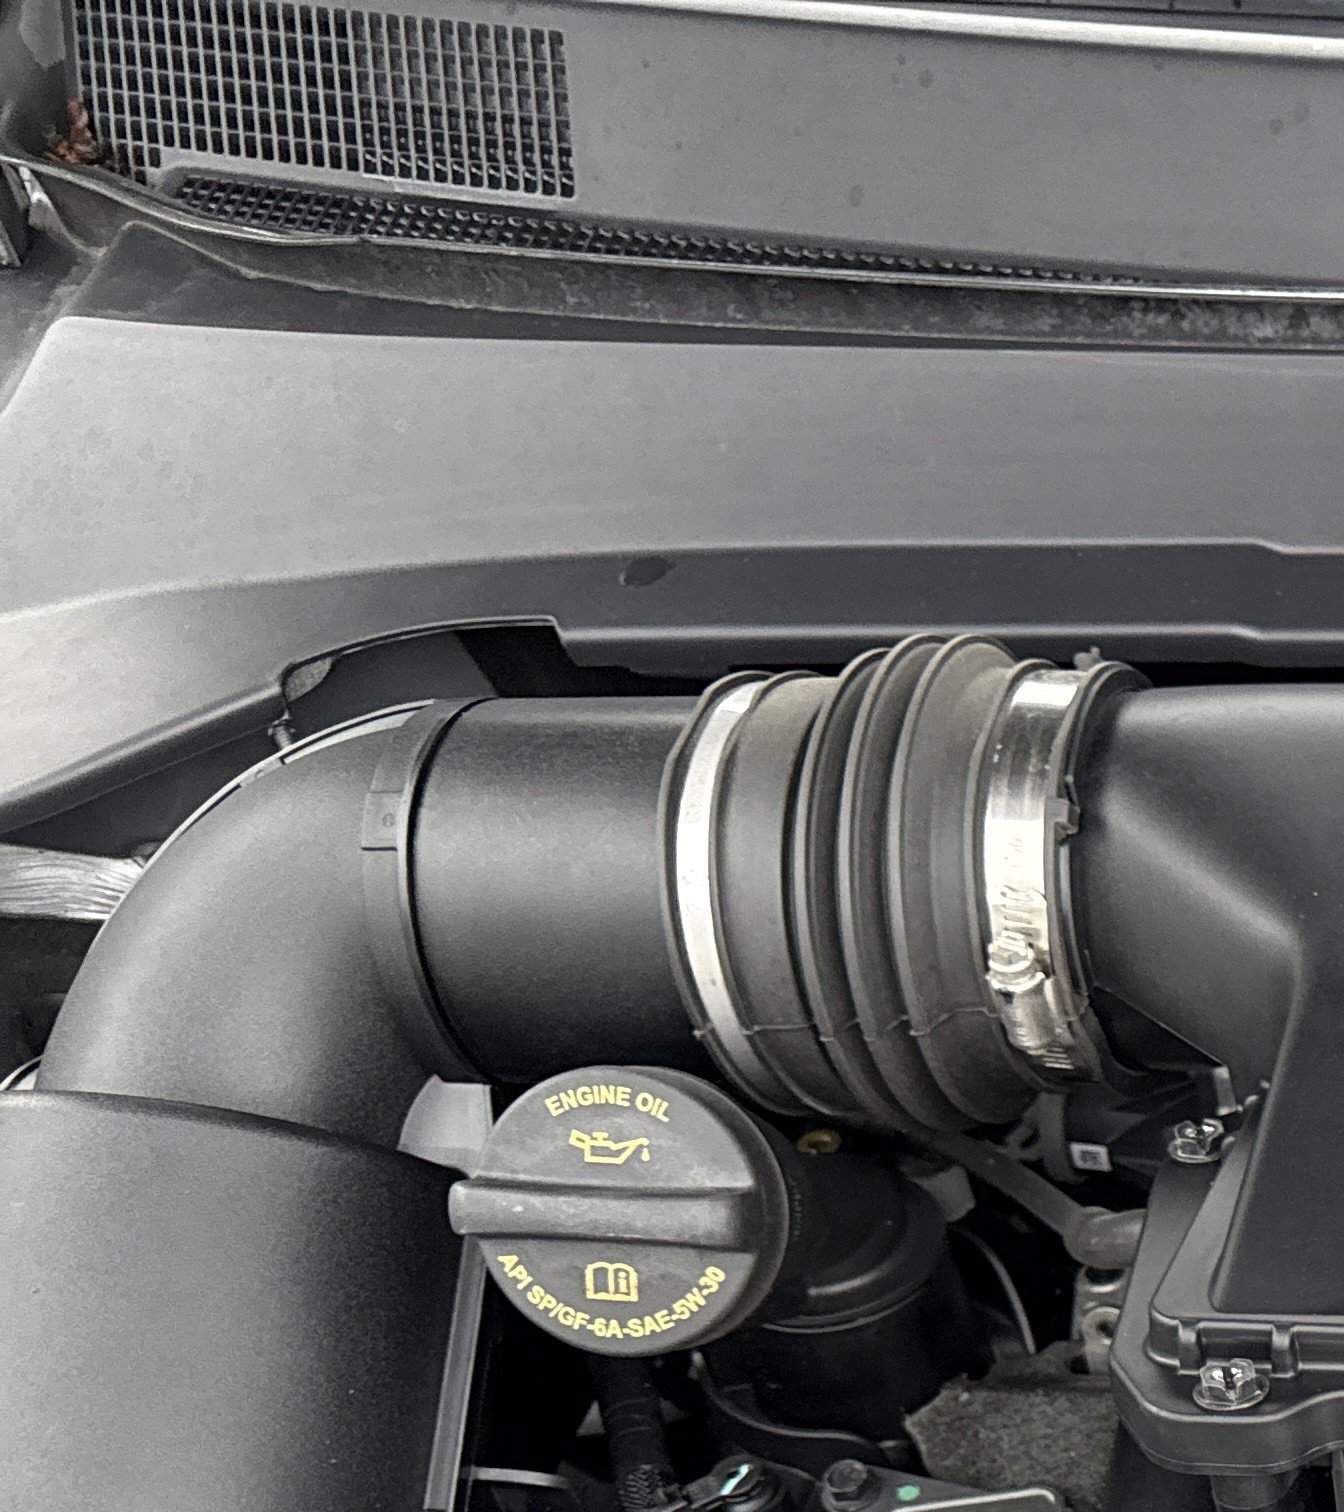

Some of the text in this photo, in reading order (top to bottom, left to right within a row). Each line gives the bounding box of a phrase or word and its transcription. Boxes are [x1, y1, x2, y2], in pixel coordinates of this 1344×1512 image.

[544, 1085, 672, 1123] ENGINE OIL
[498, 1254, 533, 1290] API
